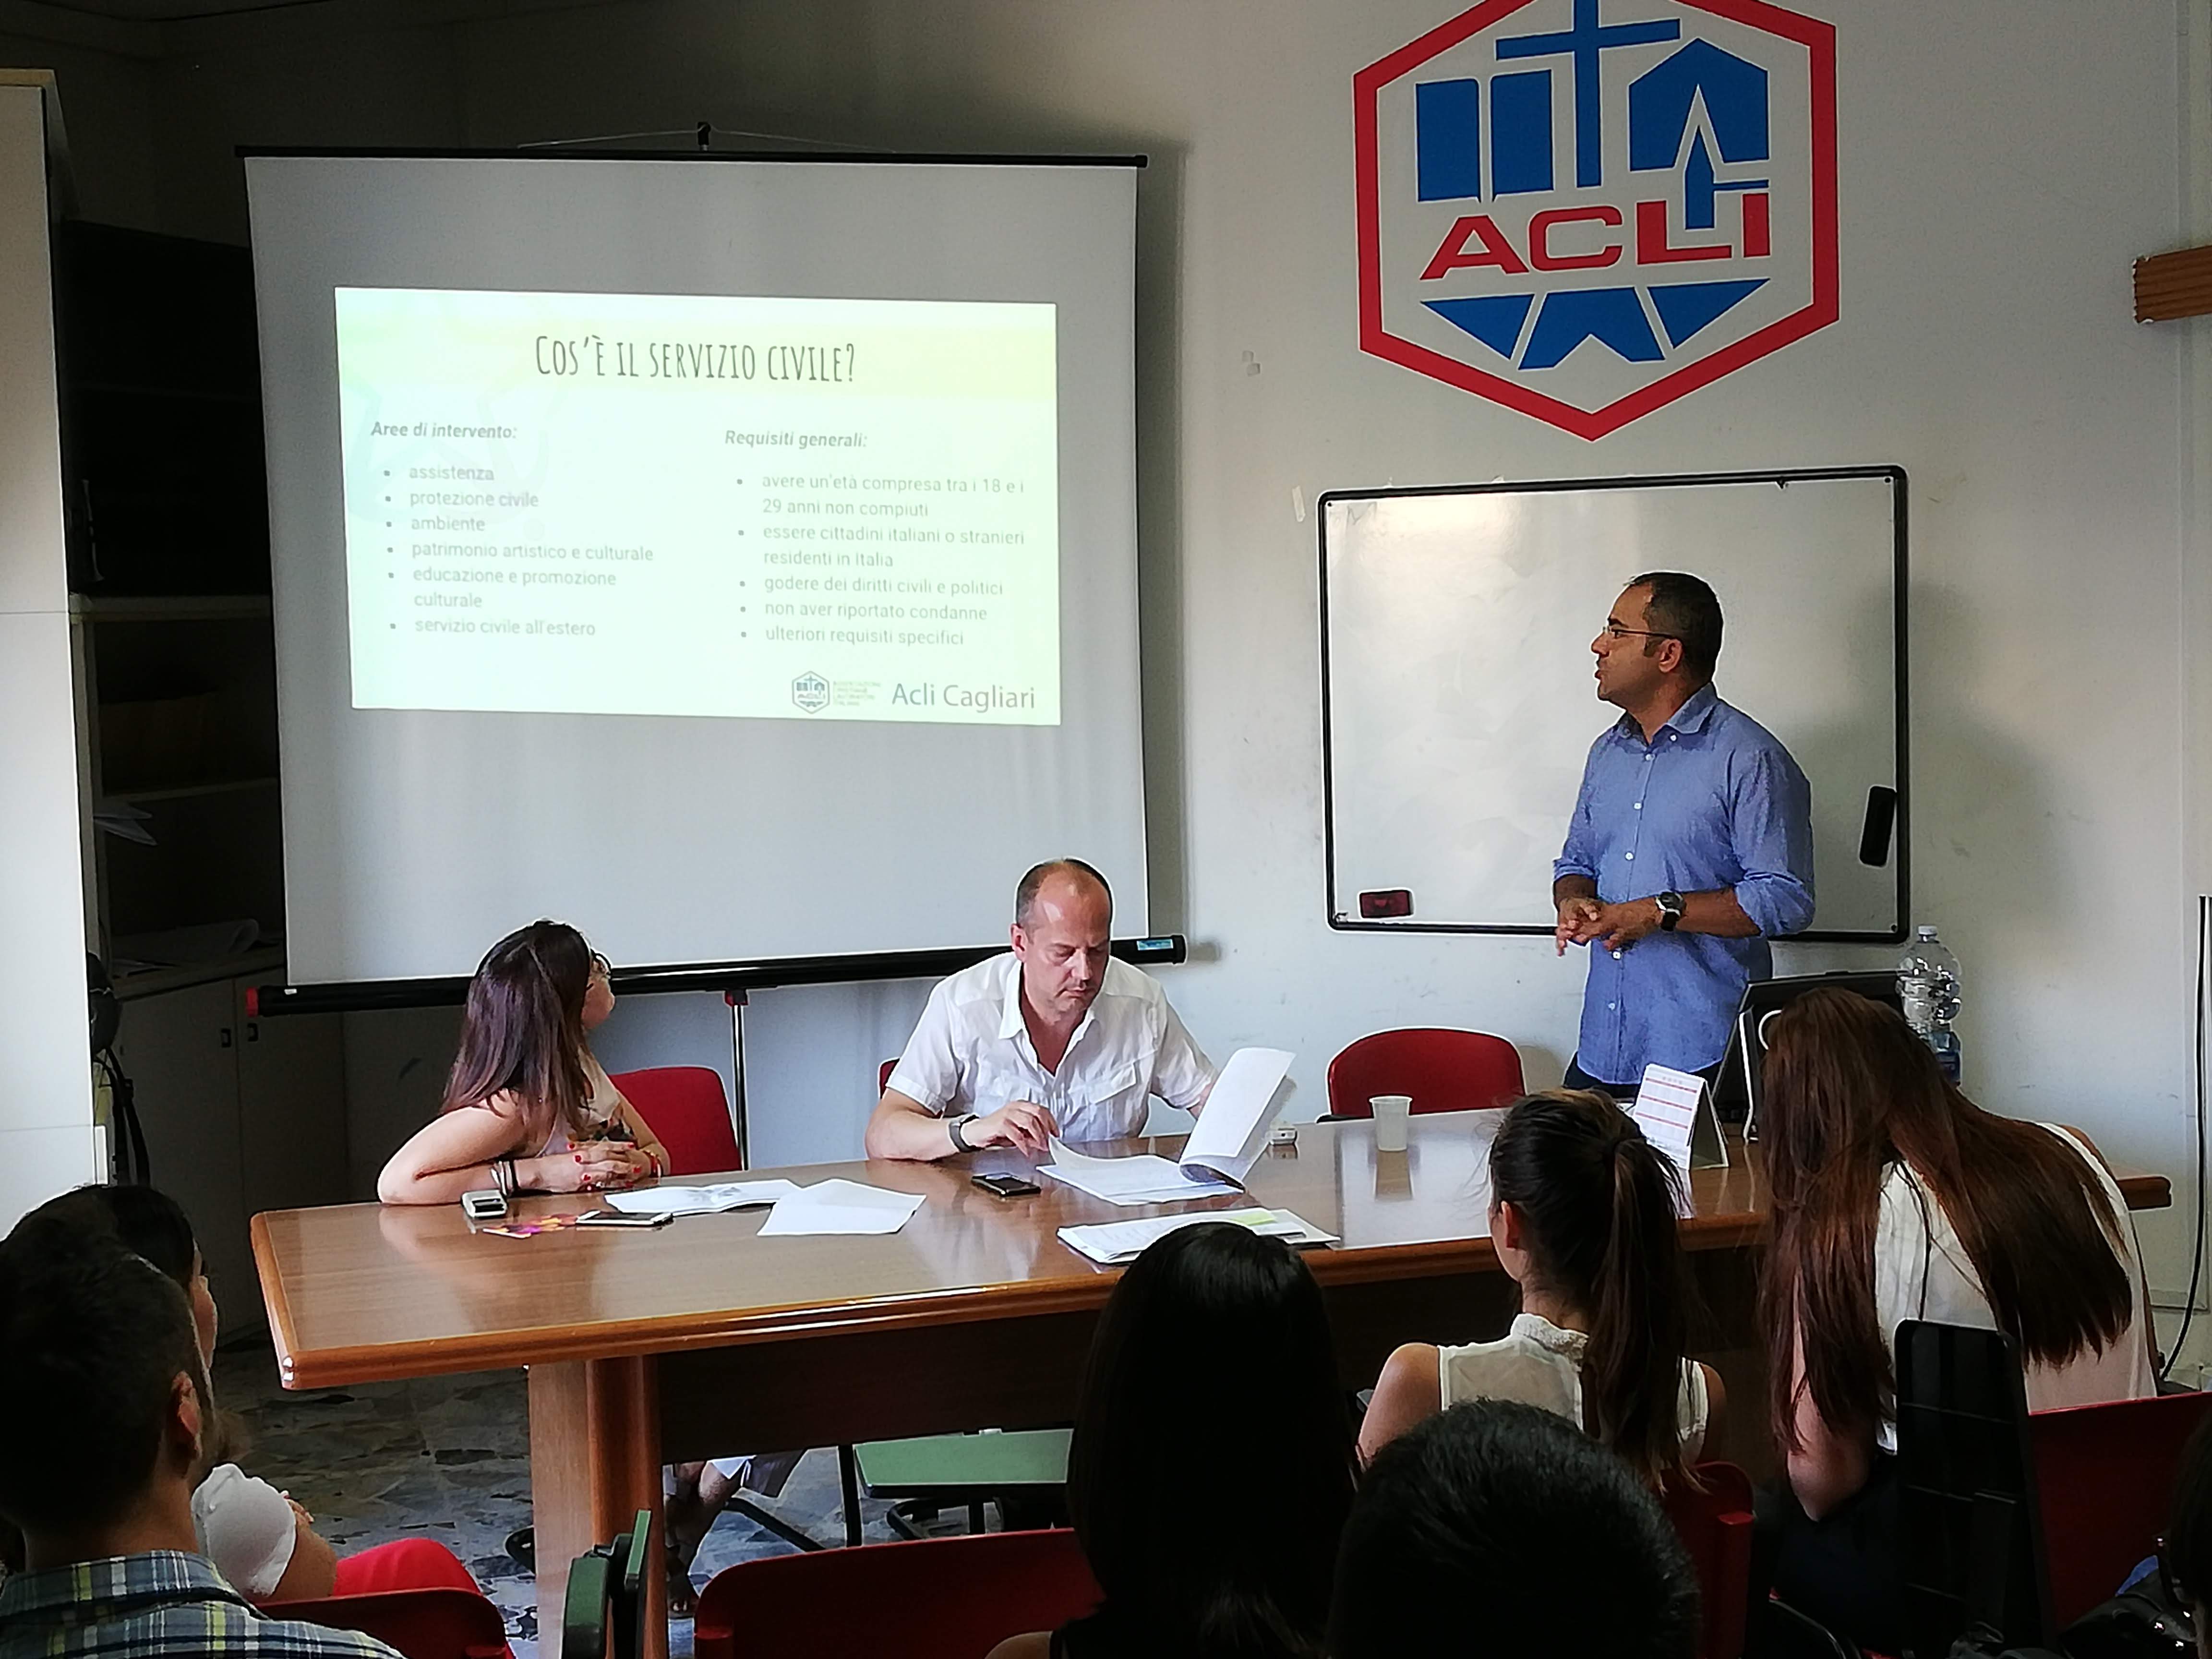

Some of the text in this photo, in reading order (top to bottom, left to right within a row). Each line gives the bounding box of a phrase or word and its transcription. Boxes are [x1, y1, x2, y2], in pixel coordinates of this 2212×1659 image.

[1420, 193, 1770, 280] ACLI
[616, 342, 639, 377] IL
[649, 342, 756, 380] SERVIZIO
[768, 343, 854, 382] CIVILE?
[369, 421, 517, 439] Aree di intervento:
[724, 430, 867, 450] Requisiti generali:
[409, 464, 495, 481] assistenza
[762, 473, 1024, 494] avere un'età compresa tra i 18 e i
[409, 490, 540, 510] protezione civile
[762, 498, 928, 520] 29 anni non compiuti
[411, 515, 486, 532] ambiente
[763, 526, 1024, 545] essere cittadini italiani o stranieri
[412, 542, 653, 561] patrimonio artistico e culturale
[764, 549, 893, 567] residenti in Italia
[413, 565, 617, 587] educazione e promozione
[764, 574, 1003, 598] godere dei diritti civili e politici
[413, 591, 483, 608] culturale
[765, 602, 987, 621] non aver riportato condanne
[414, 617, 476, 633] servizio
[480, 618, 521, 634] civile
[765, 625, 963, 648] ulteriori requisiti specifici
[891, 682, 1034, 714] Acli Cagliari
